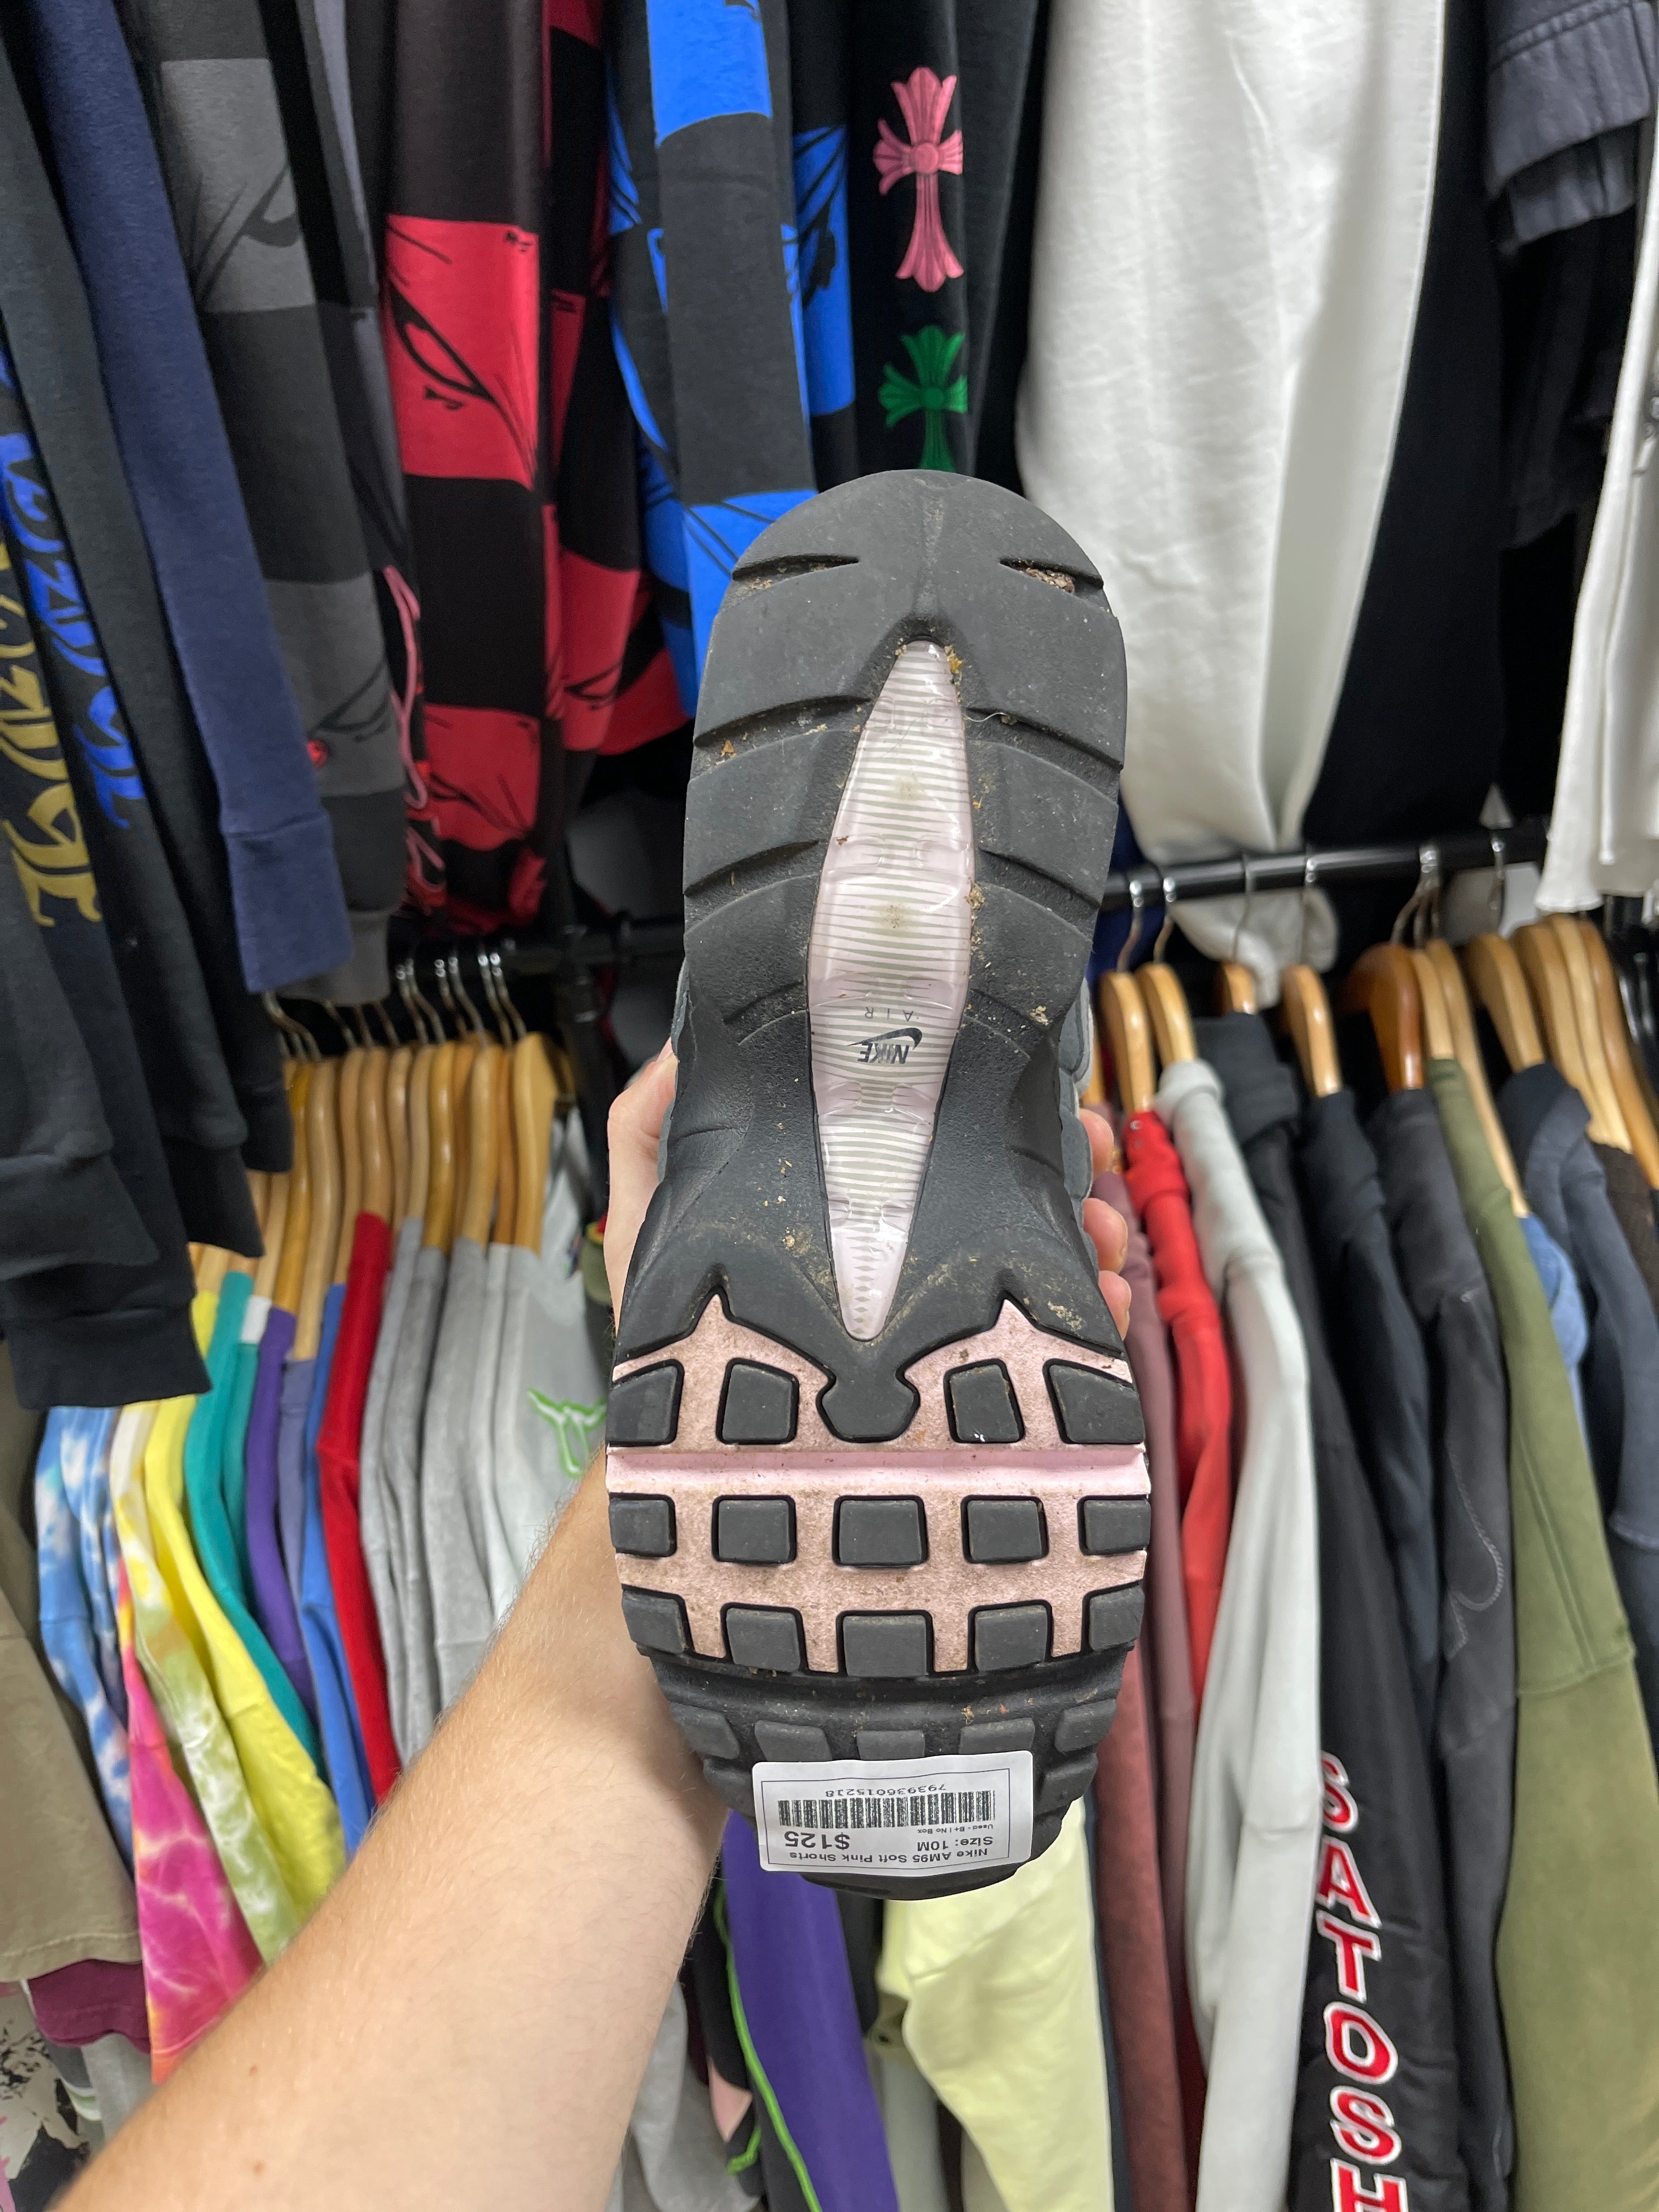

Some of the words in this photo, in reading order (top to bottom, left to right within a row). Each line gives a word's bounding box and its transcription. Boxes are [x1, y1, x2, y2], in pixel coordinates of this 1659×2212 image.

[865, 1007, 913, 1022] AIR
[857, 1043, 910, 1064] NIKE
[825, 1784, 947, 1797] 793936015218
[784, 1830, 850, 1850] $125
[955, 1836, 993, 1846] Size:
[917, 1841, 949, 1851] 10M
[789, 1852, 836, 1861] Shorts
[912, 1852, 951, 1863] AM95
[957, 1848, 988, 1857] Nike
[842, 1854, 873, 1863] Pink
